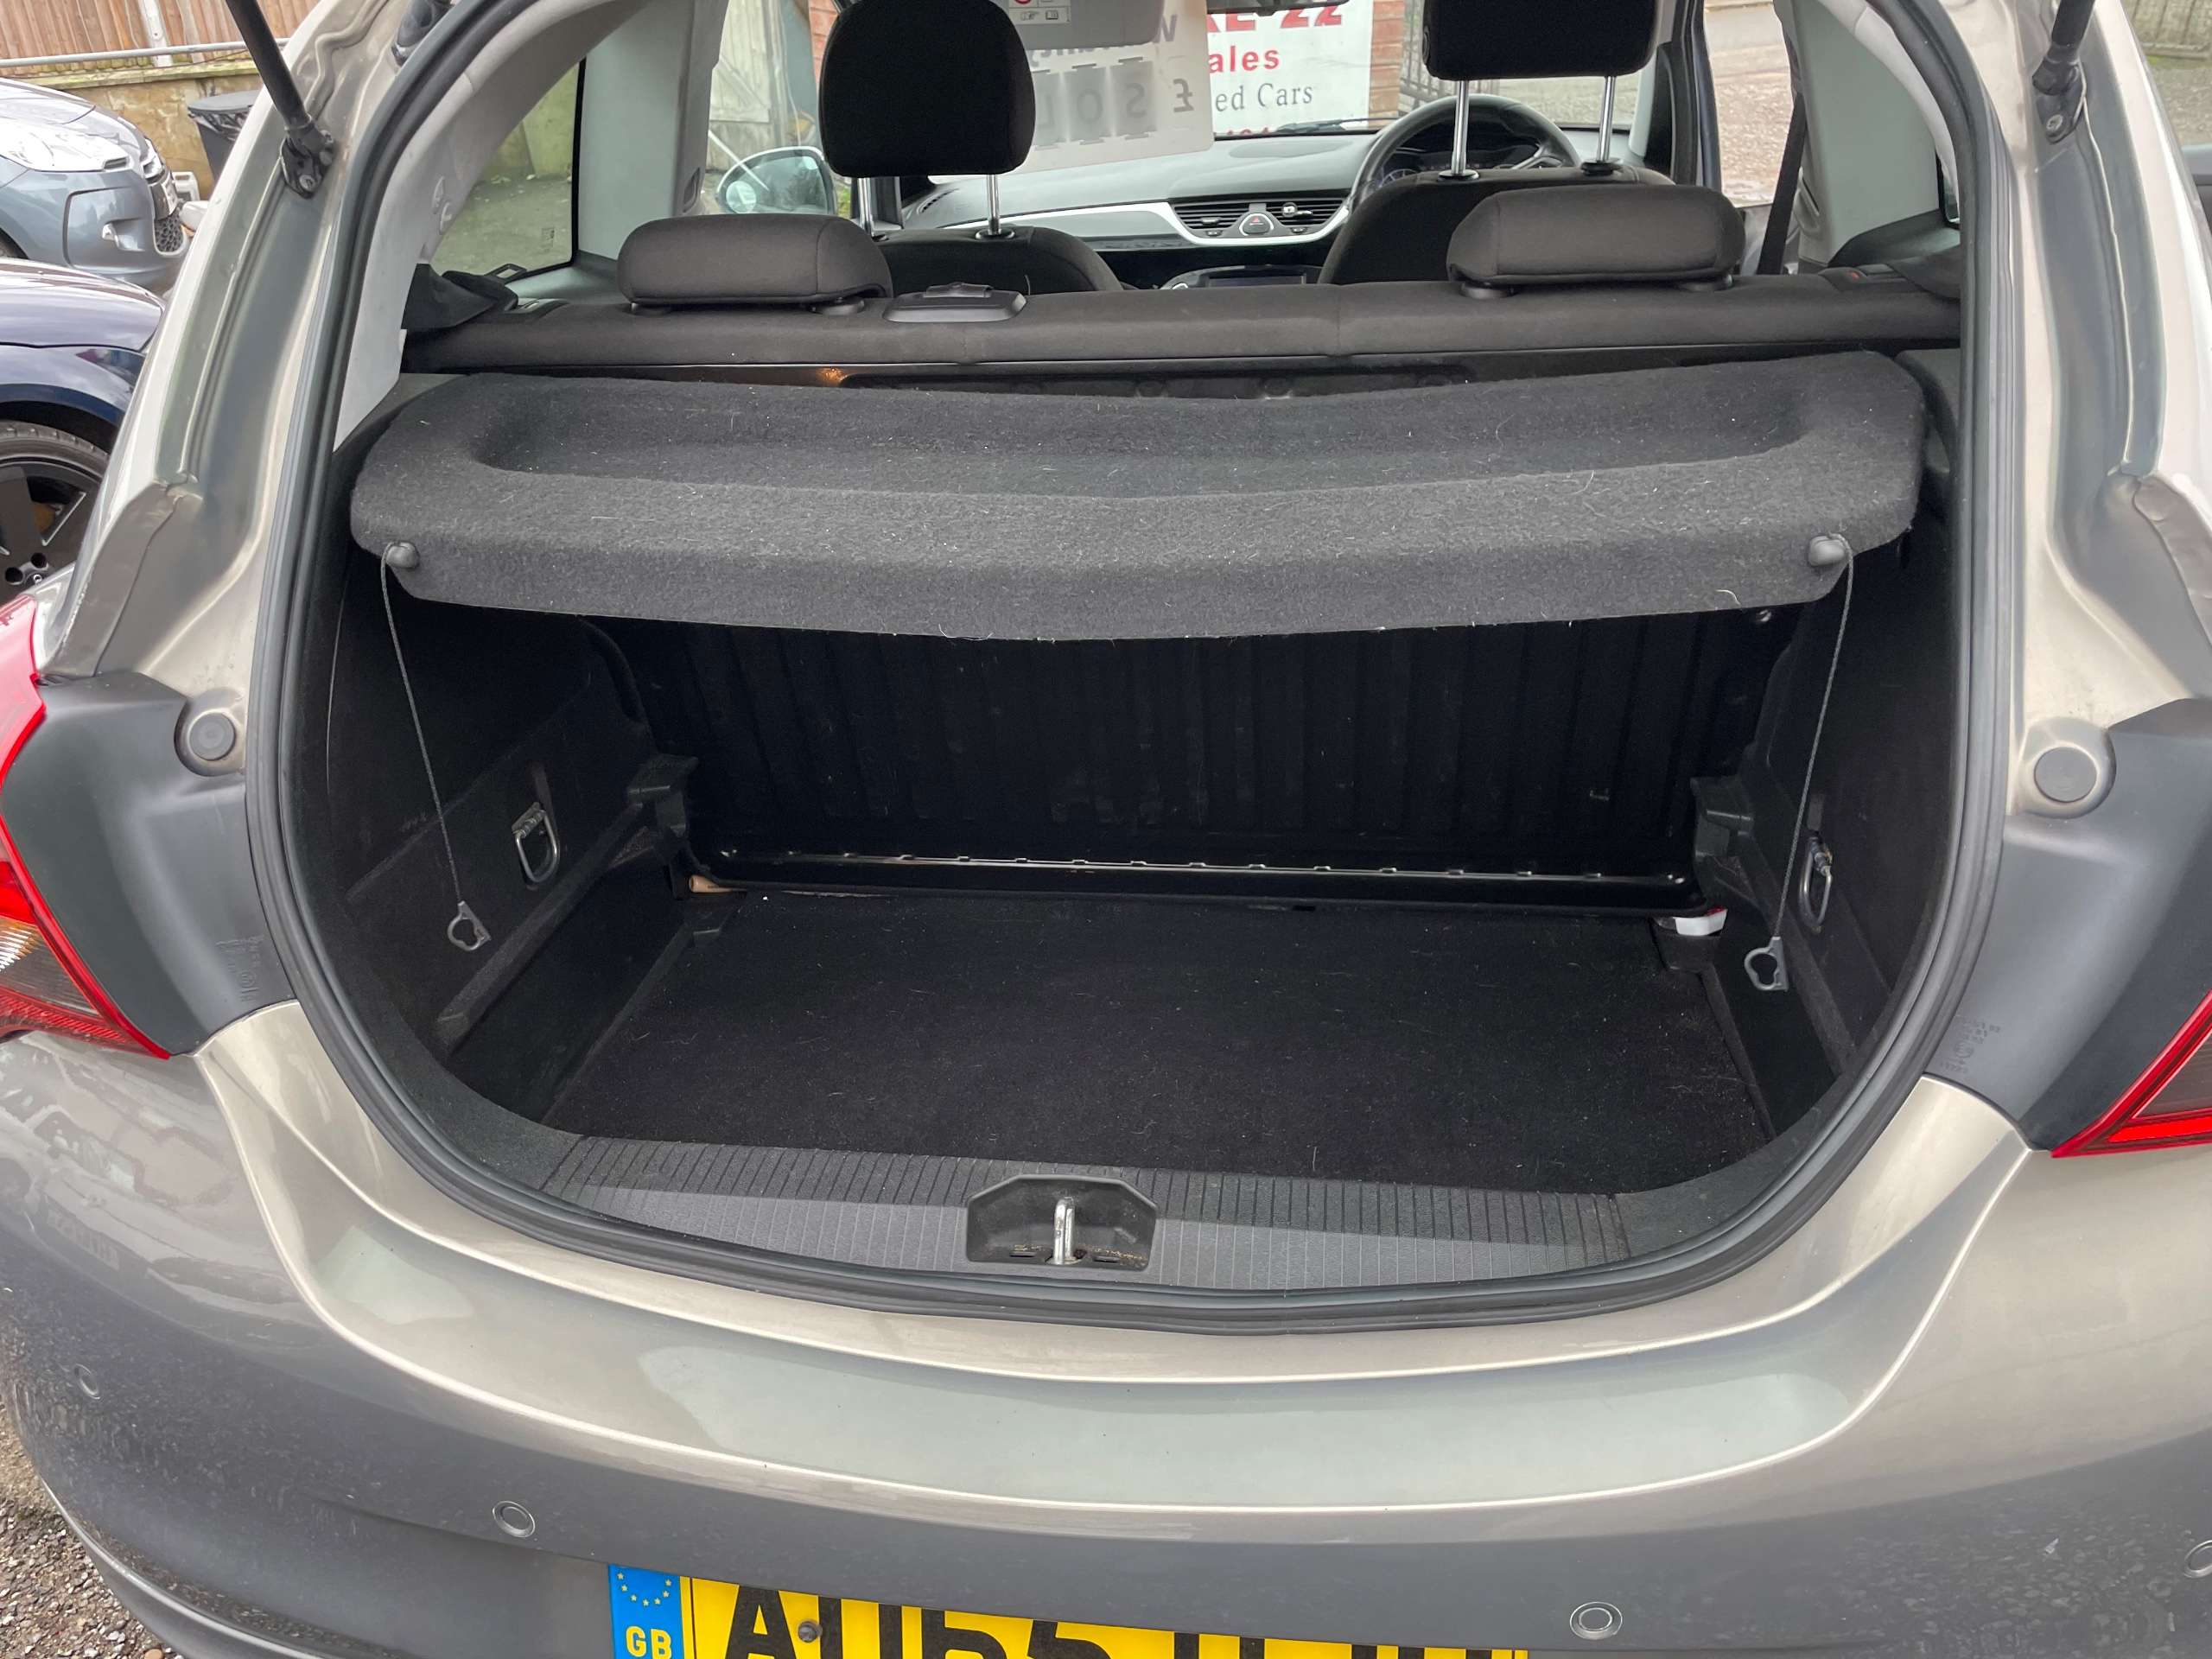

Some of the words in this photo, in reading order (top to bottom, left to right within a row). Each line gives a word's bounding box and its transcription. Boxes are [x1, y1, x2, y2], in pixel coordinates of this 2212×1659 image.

[1208, 46, 1280, 73] ales
[1215, 85, 1244, 112] ed
[1257, 83, 1313, 108] Cars
[626, 1625, 672, 1659] GB
